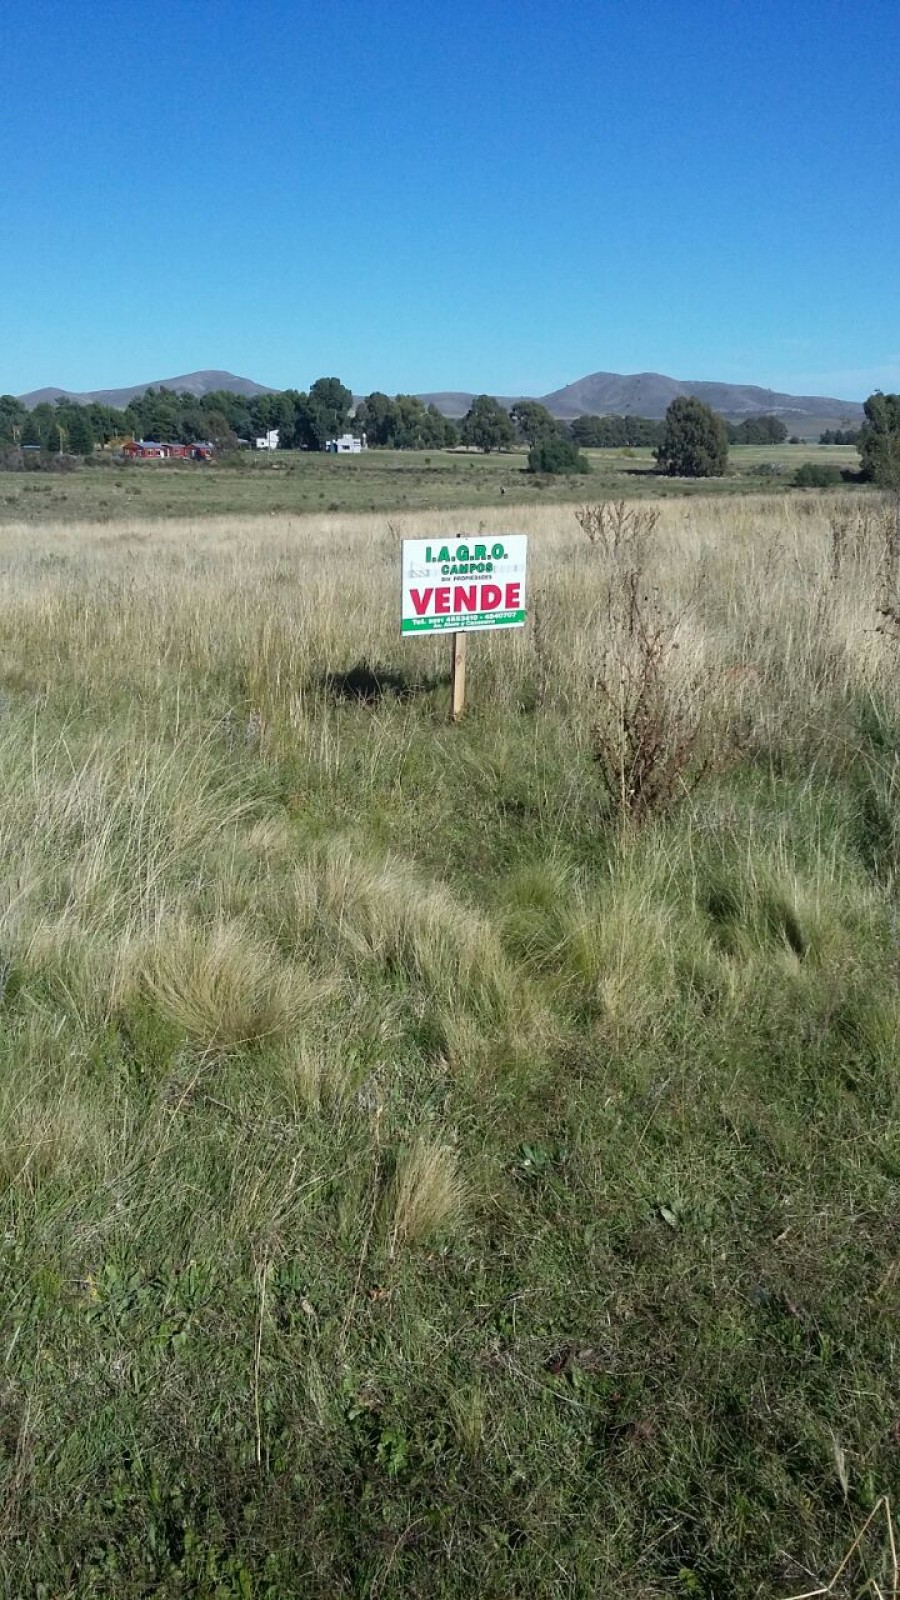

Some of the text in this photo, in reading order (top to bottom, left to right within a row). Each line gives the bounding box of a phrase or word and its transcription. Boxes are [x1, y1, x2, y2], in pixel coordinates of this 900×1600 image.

[426, 543, 508, 563] I.A.G.R.O.
[441, 562, 493, 576] CAMPOS
[410, 582, 520, 615] VENDE
